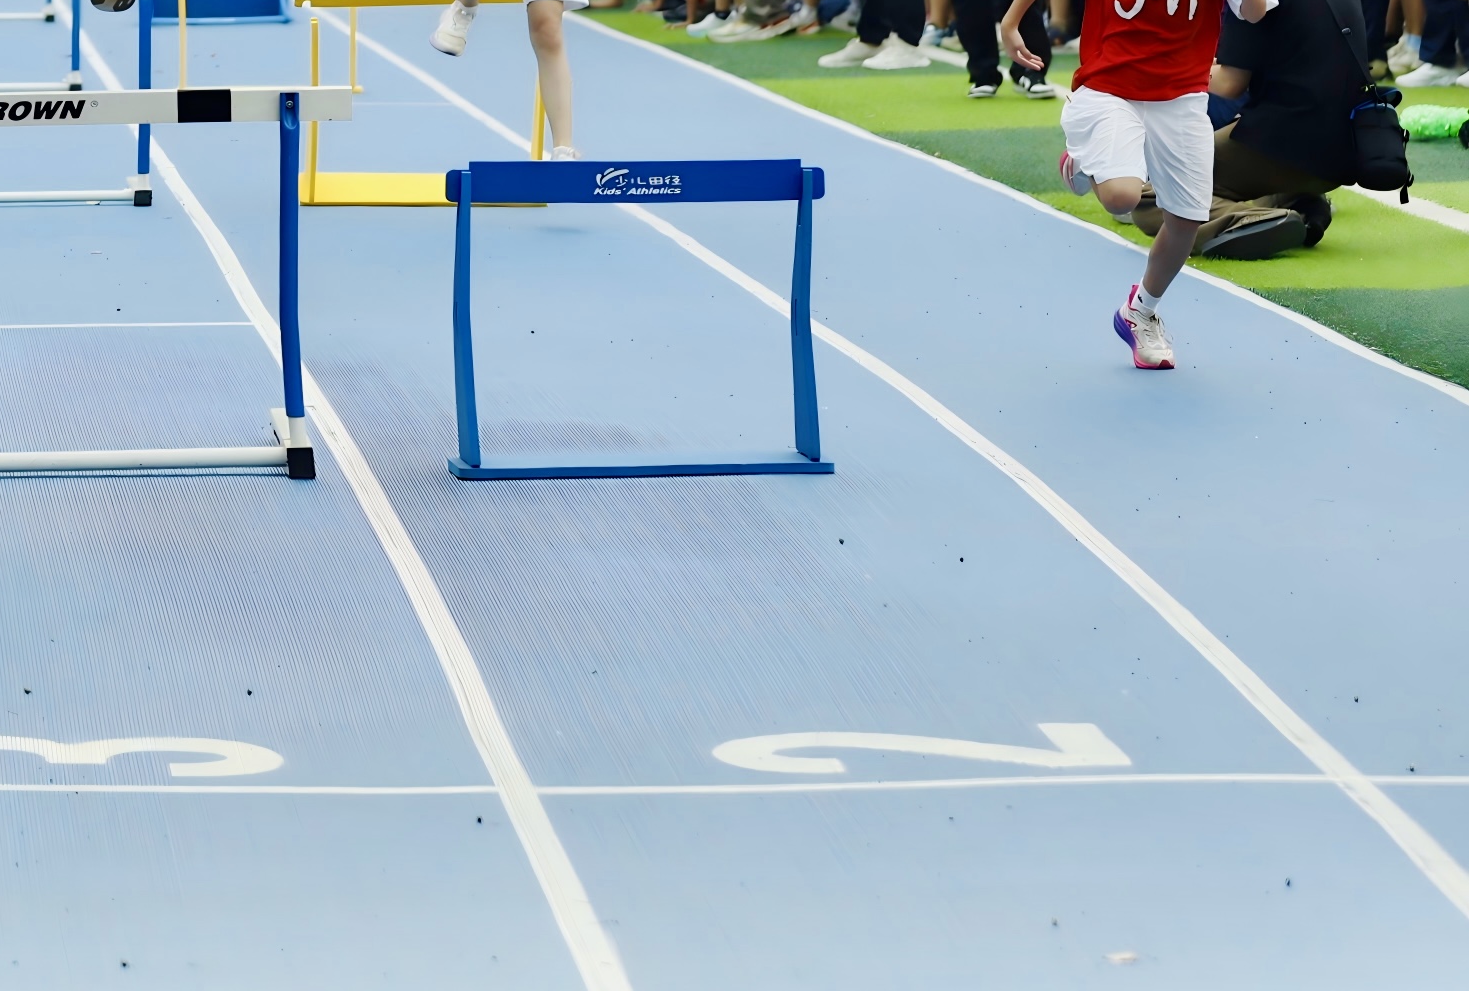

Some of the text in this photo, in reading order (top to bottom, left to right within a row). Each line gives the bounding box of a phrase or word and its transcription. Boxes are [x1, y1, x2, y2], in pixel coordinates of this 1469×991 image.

[615, 175, 682, 187] 少儿田径
[627, 186, 682, 196] Athletics
[712, 722, 1132, 774] 2
